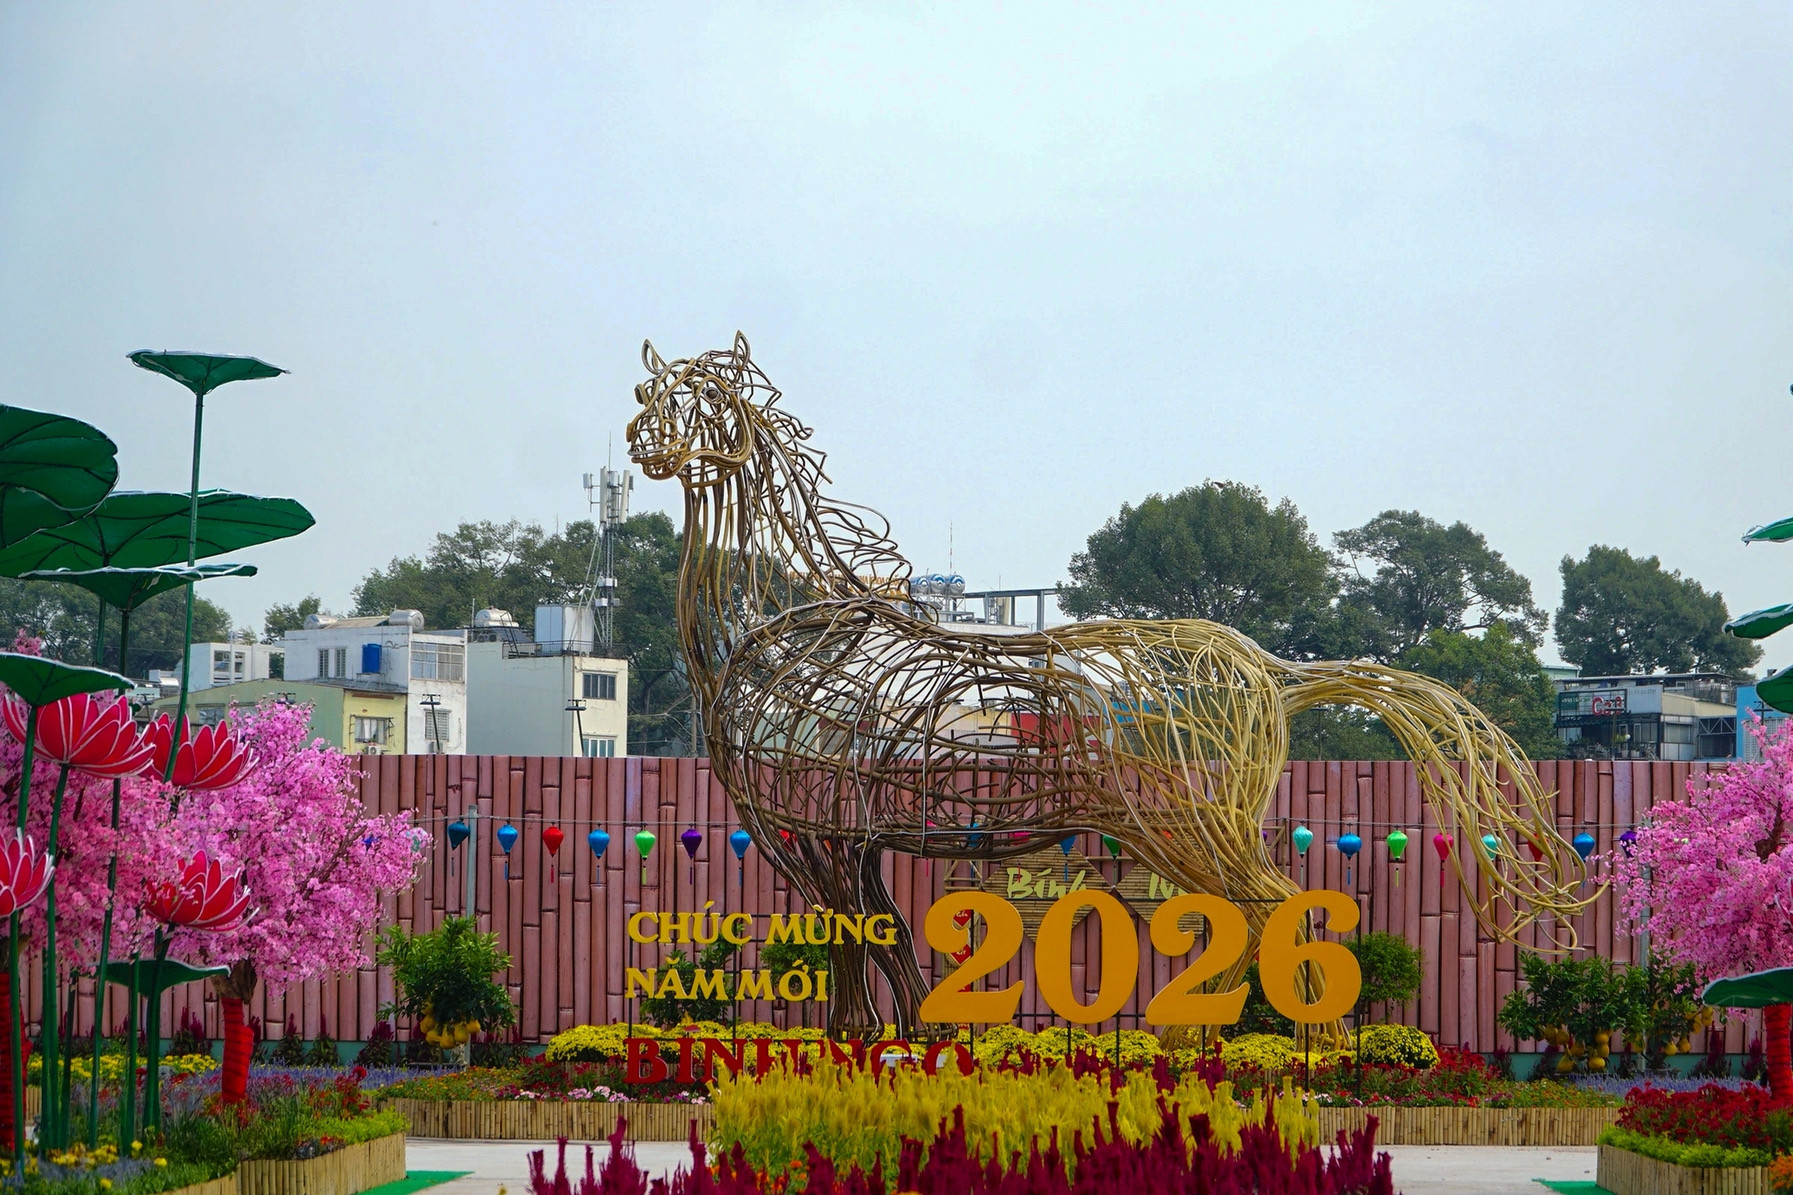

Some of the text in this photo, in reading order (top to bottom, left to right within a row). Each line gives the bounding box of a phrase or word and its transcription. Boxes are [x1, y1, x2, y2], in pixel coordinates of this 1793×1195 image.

[627, 900, 898, 946] CHÚC MỪNG
[625, 956, 829, 1002] NĂM MỚI
[919, 889, 1362, 1026] 2026
